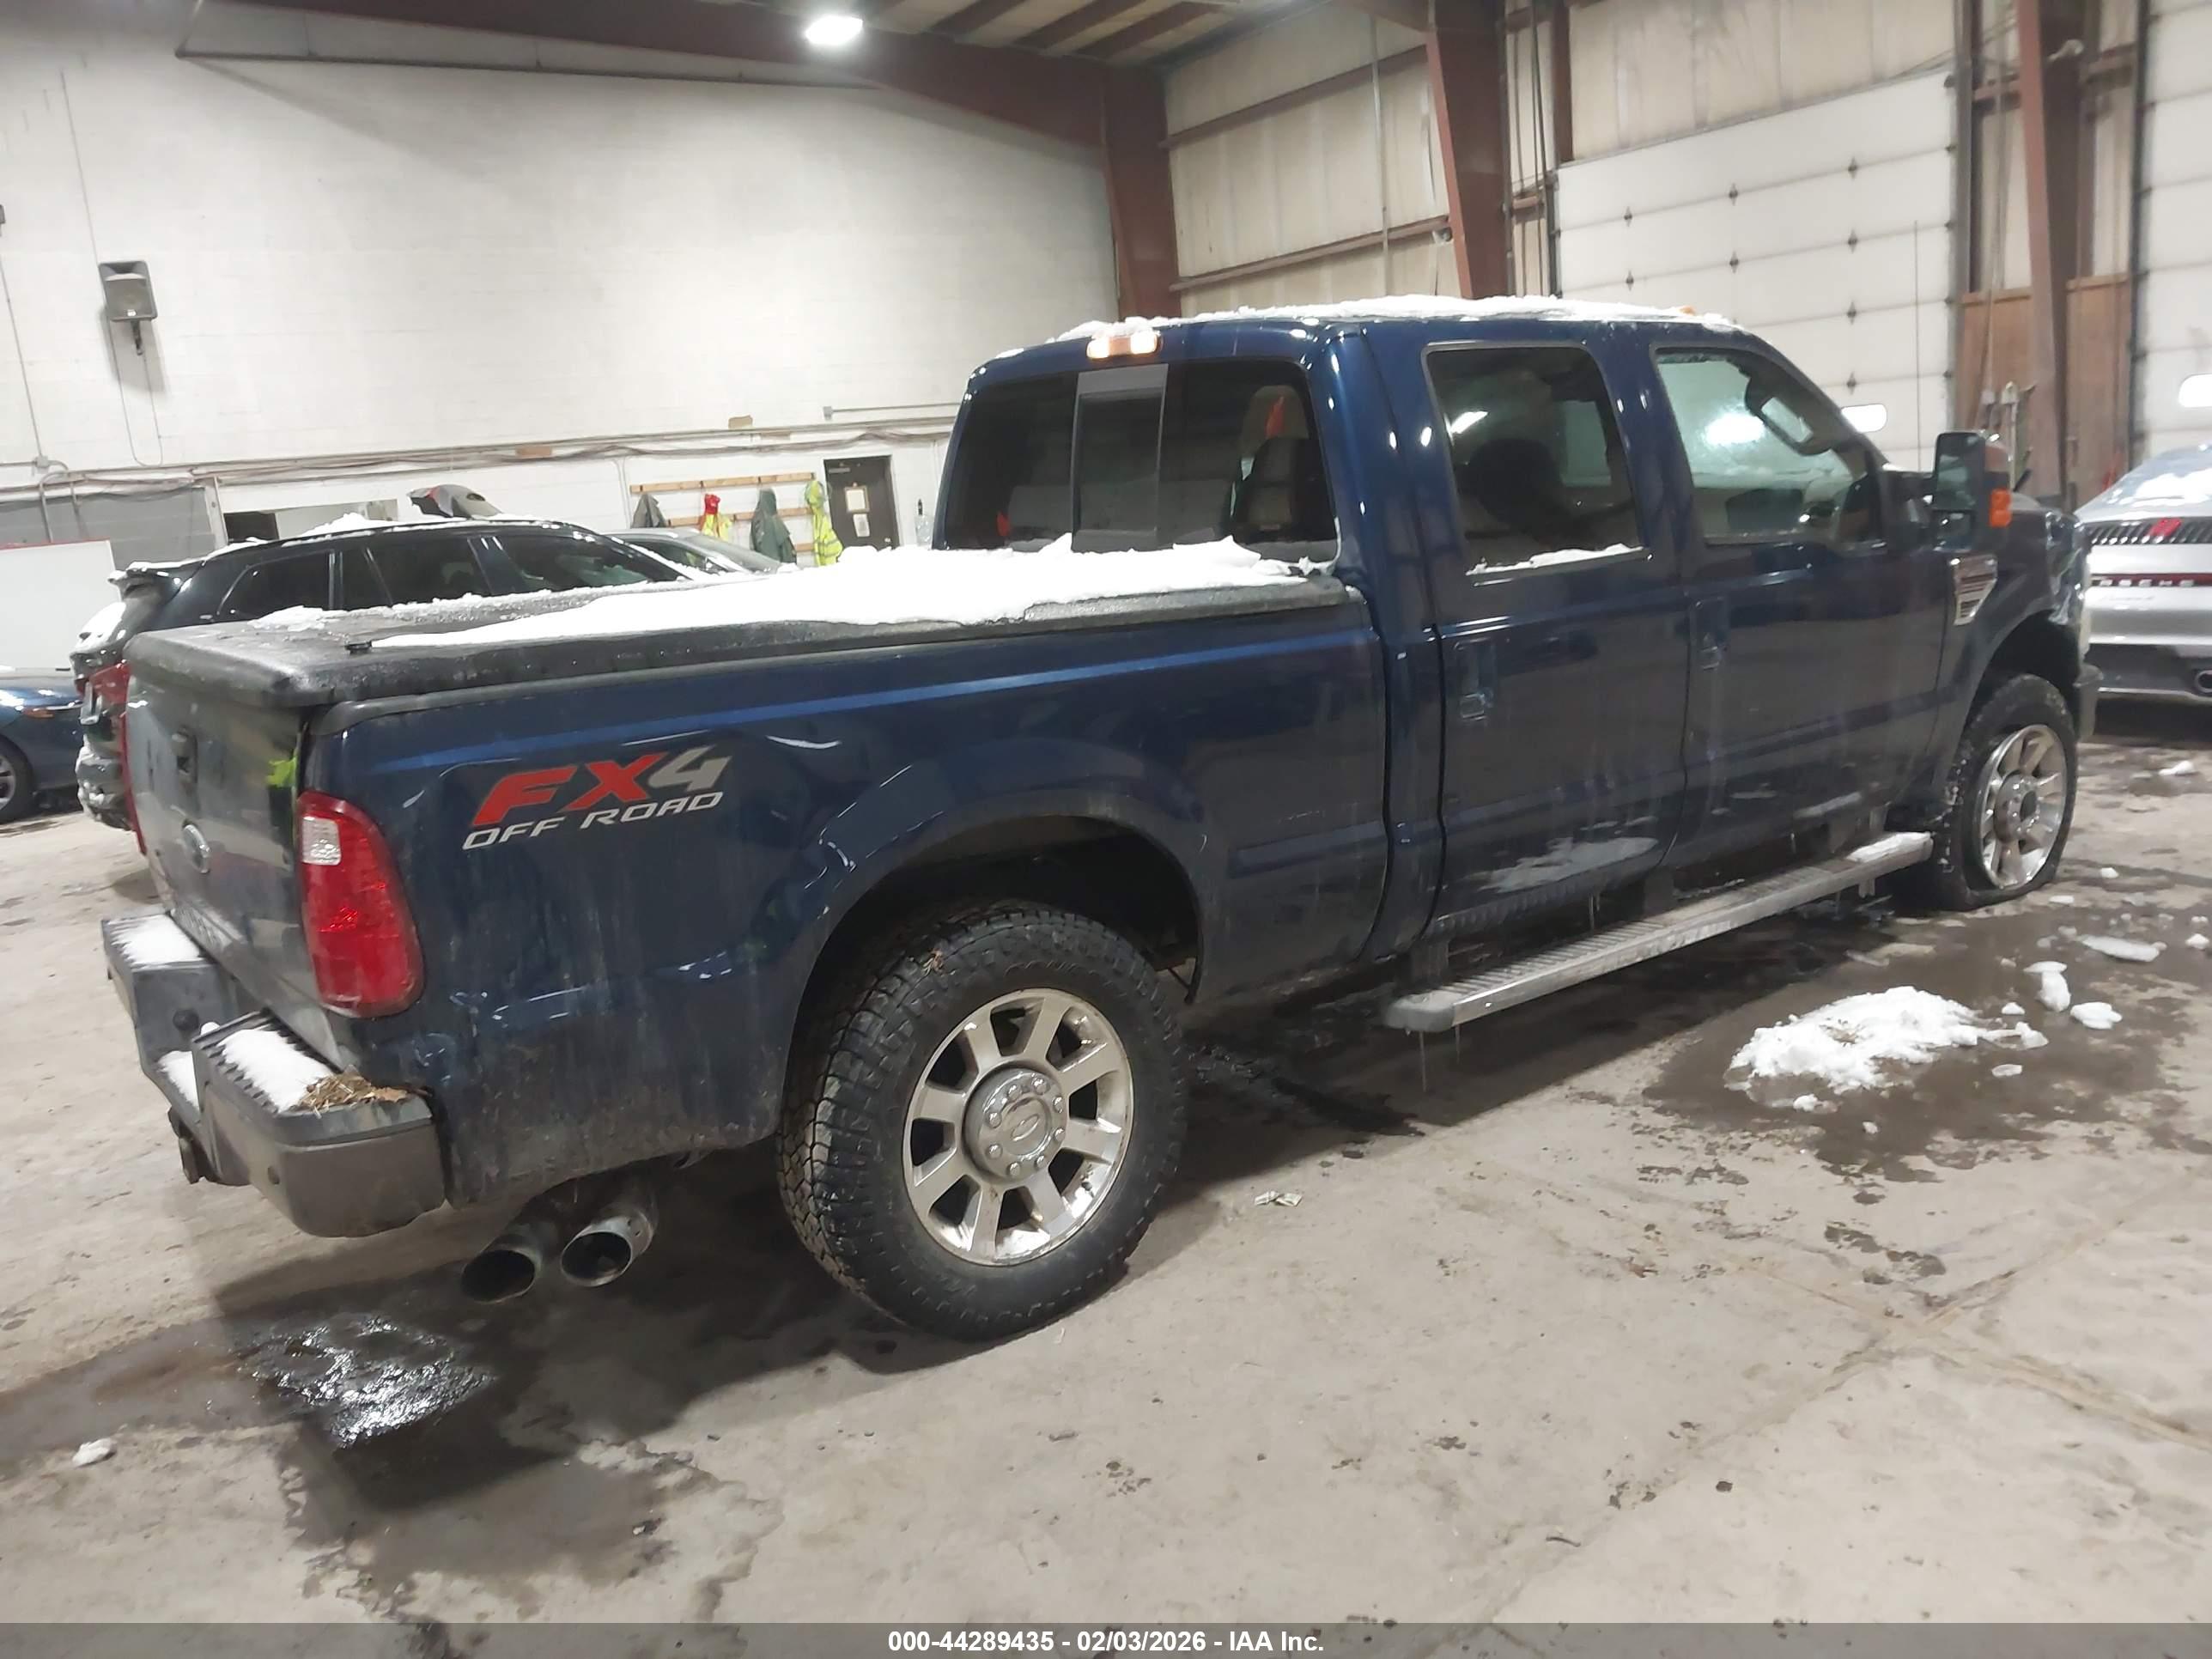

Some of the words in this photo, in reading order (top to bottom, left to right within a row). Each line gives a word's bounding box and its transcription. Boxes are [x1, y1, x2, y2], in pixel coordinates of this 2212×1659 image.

[471, 744, 732, 826] FX4
[462, 817, 565, 850] OFF
[580, 791, 723, 830] ROAD
